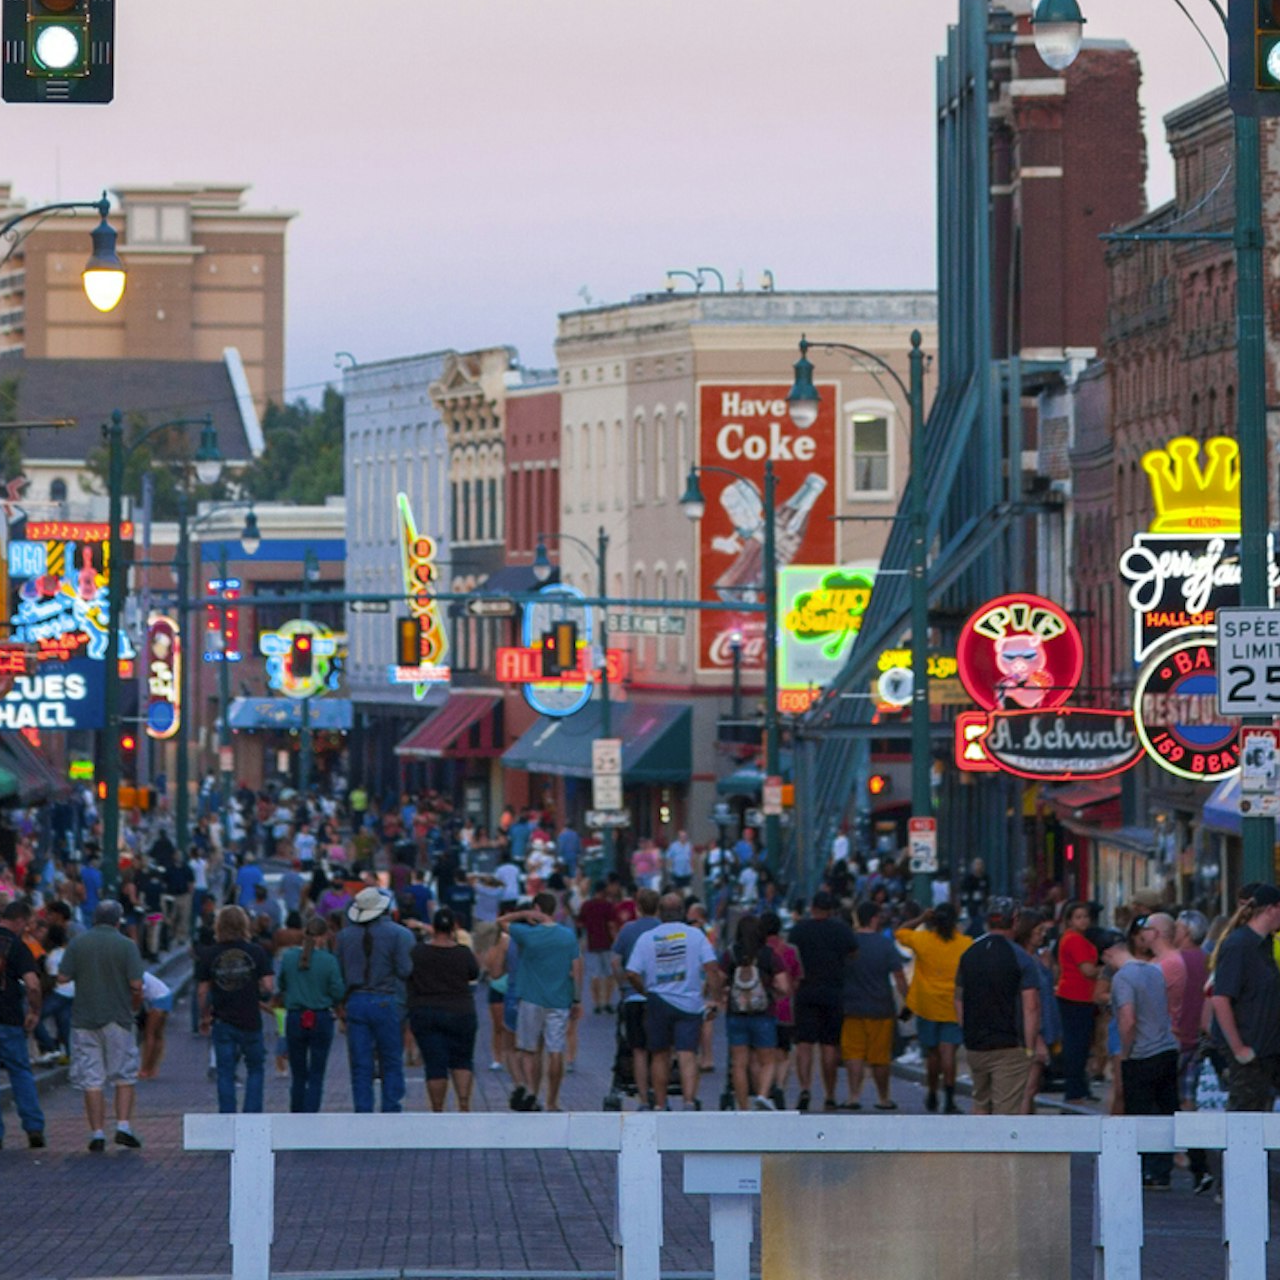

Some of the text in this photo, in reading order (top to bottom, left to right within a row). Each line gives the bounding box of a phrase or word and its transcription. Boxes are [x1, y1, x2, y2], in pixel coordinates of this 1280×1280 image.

[721, 391, 787, 417] Have
[715, 422, 818, 461] Coke
[973, 603, 1067, 641] PIG
[1146, 611, 1215, 628] HALL OF
[988, 715, 1133, 750] A. Schwab
